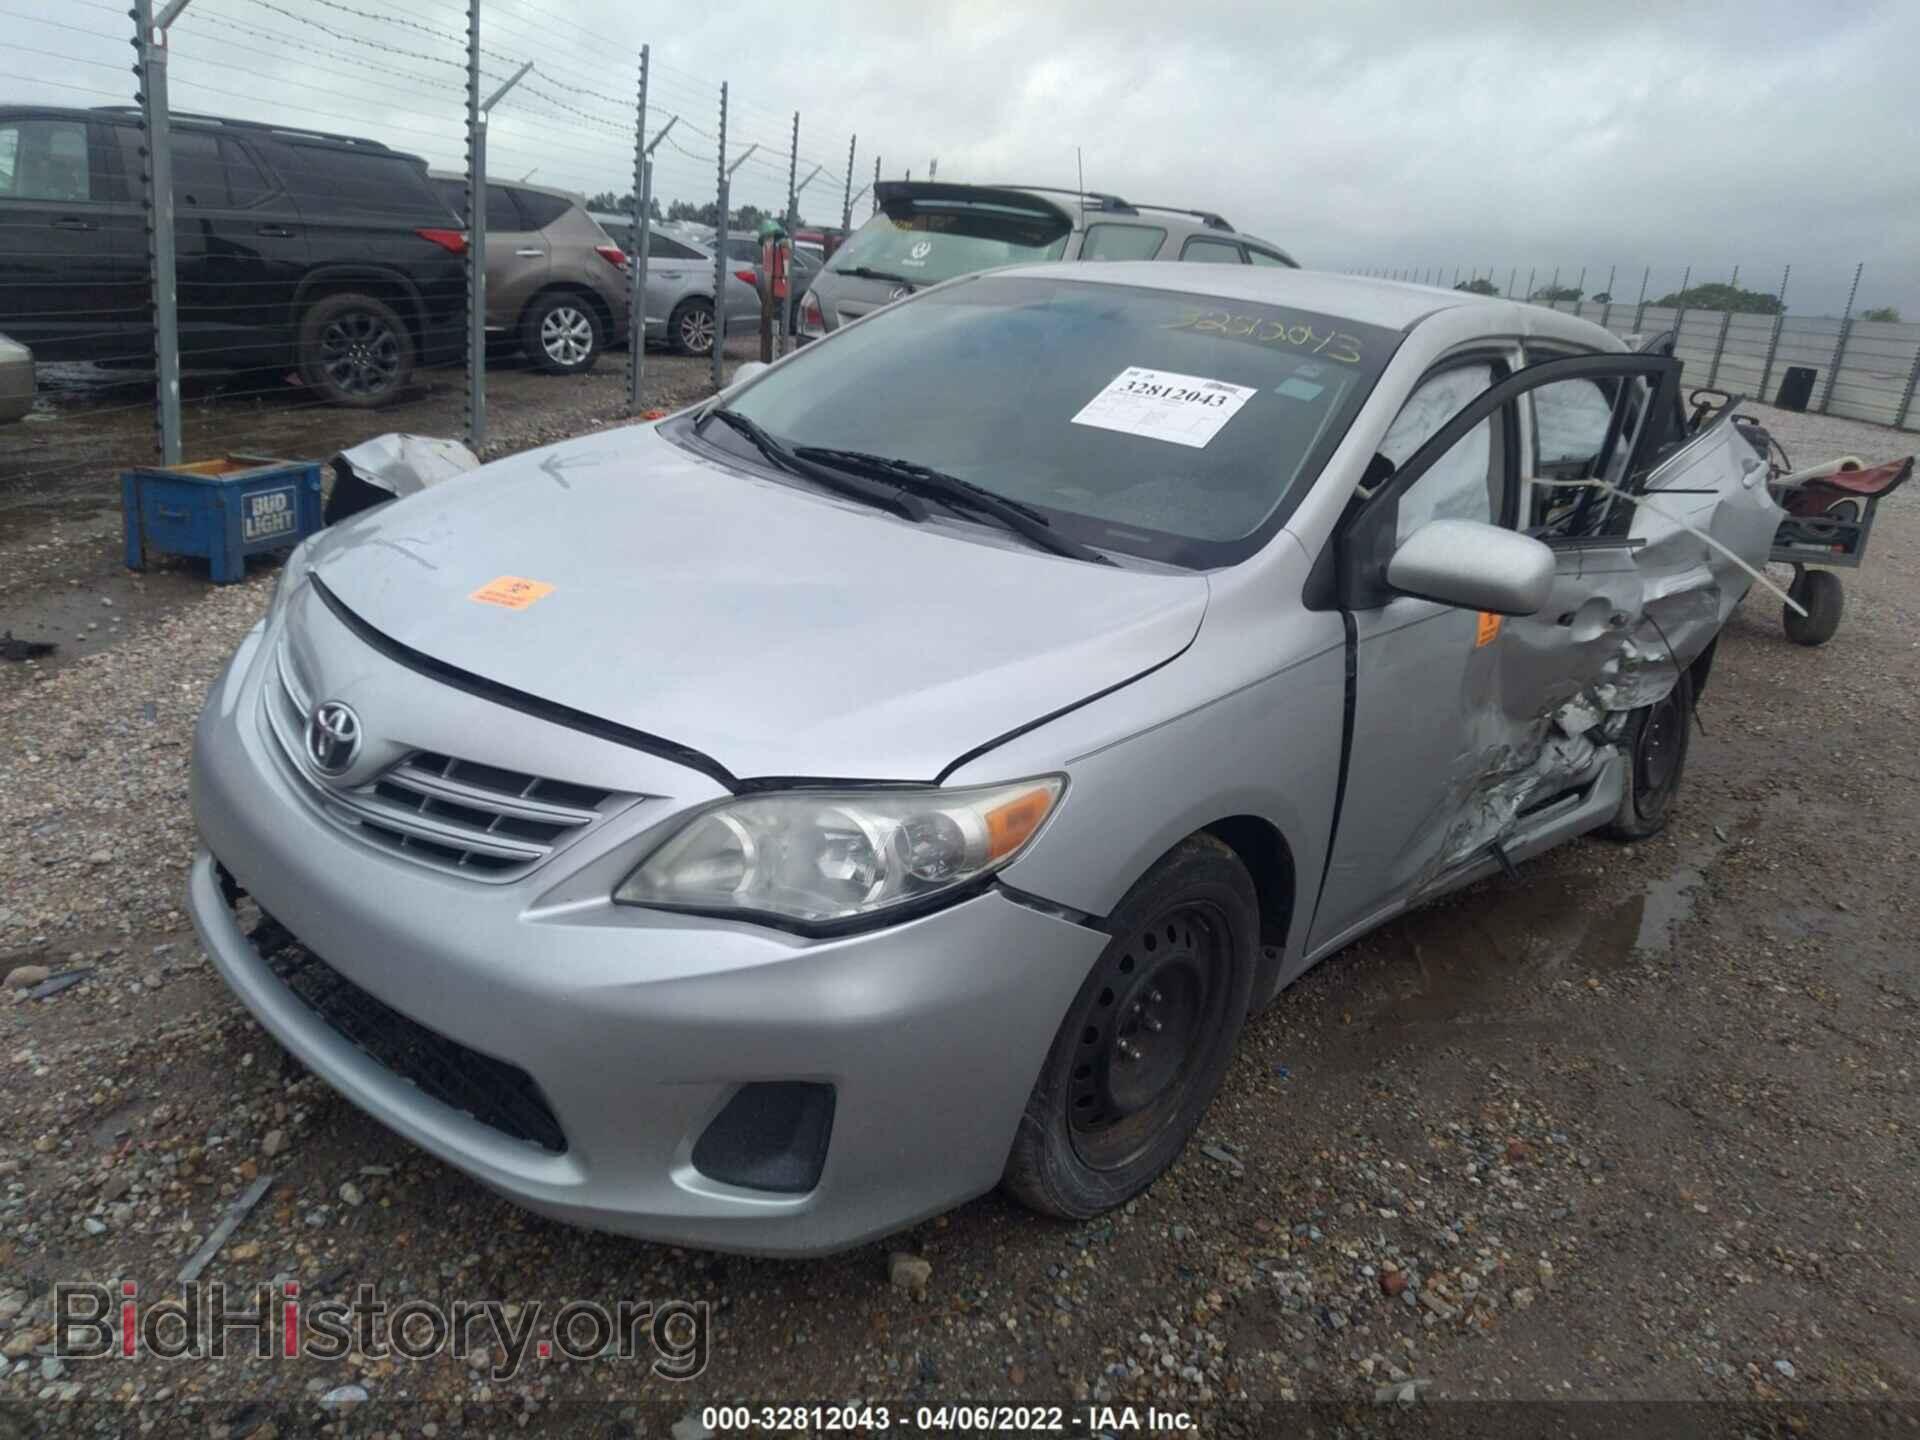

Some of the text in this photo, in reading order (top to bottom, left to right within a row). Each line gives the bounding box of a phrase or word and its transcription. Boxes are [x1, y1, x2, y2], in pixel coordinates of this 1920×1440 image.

[1119, 380, 1228, 408] 32812043
[252, 492, 287, 515] BUD
[245, 510, 294, 537] LIGHT
